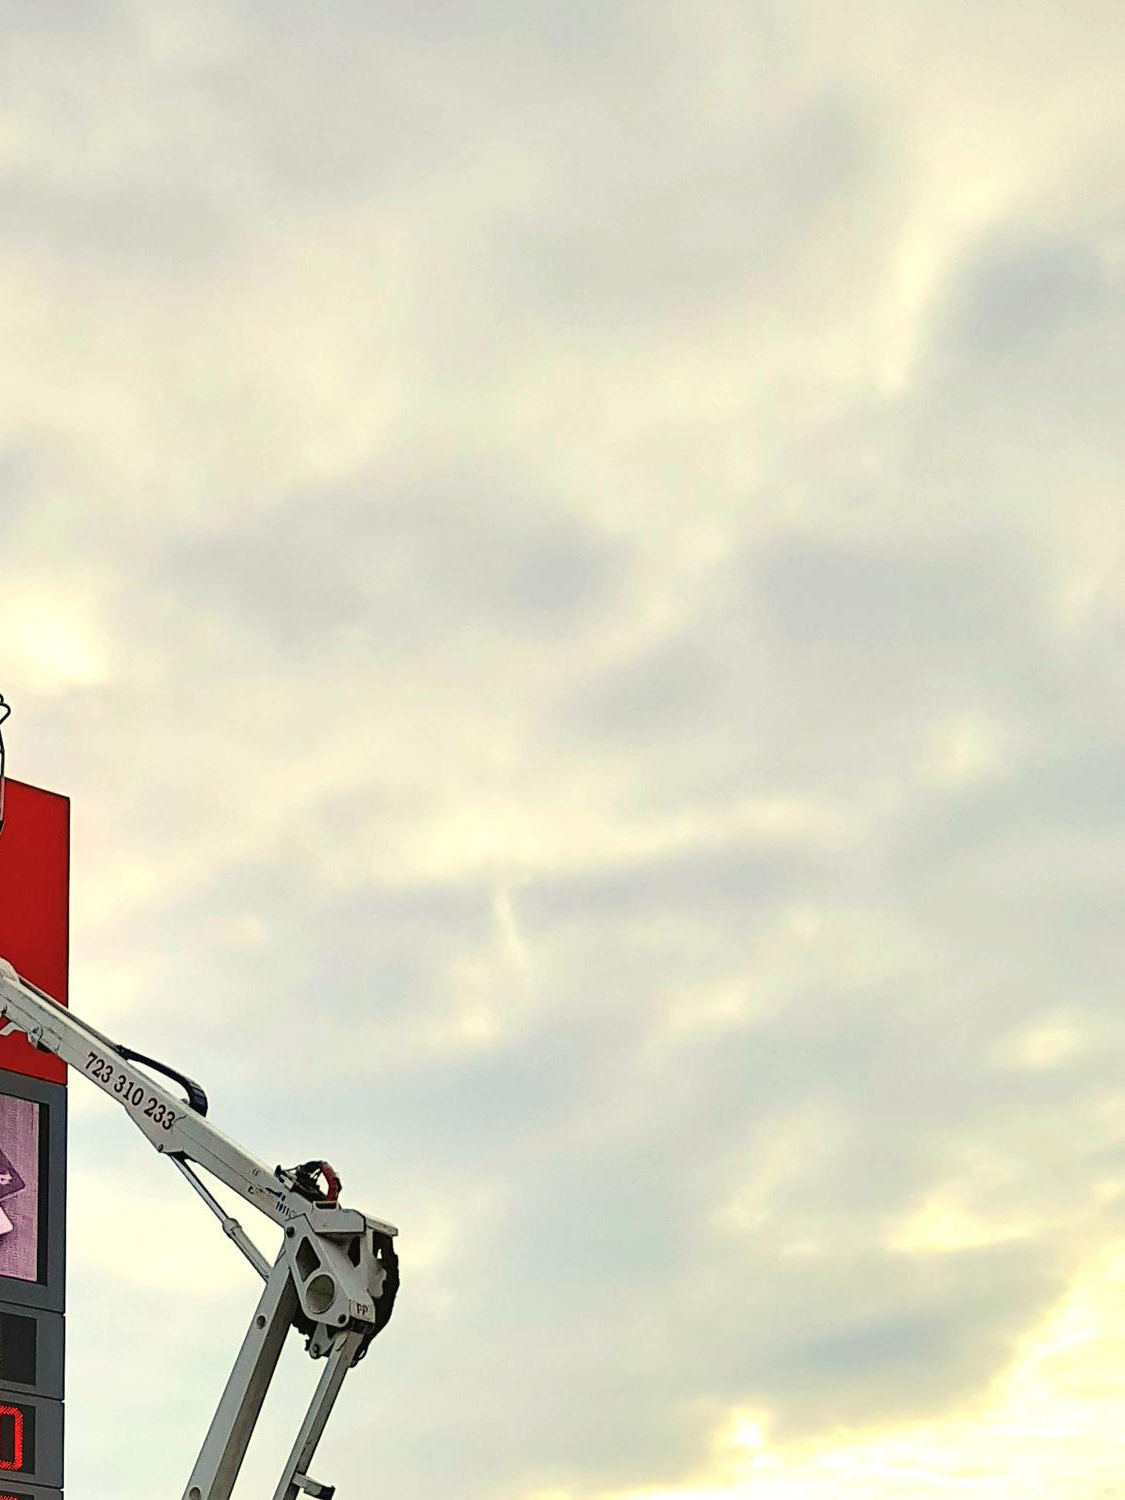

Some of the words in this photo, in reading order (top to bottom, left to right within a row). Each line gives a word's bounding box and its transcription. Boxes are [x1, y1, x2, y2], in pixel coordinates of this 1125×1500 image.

[85, 1051, 114, 1084] 723
[113, 1074, 145, 1107] 310
[143, 1097, 176, 1131] 233
